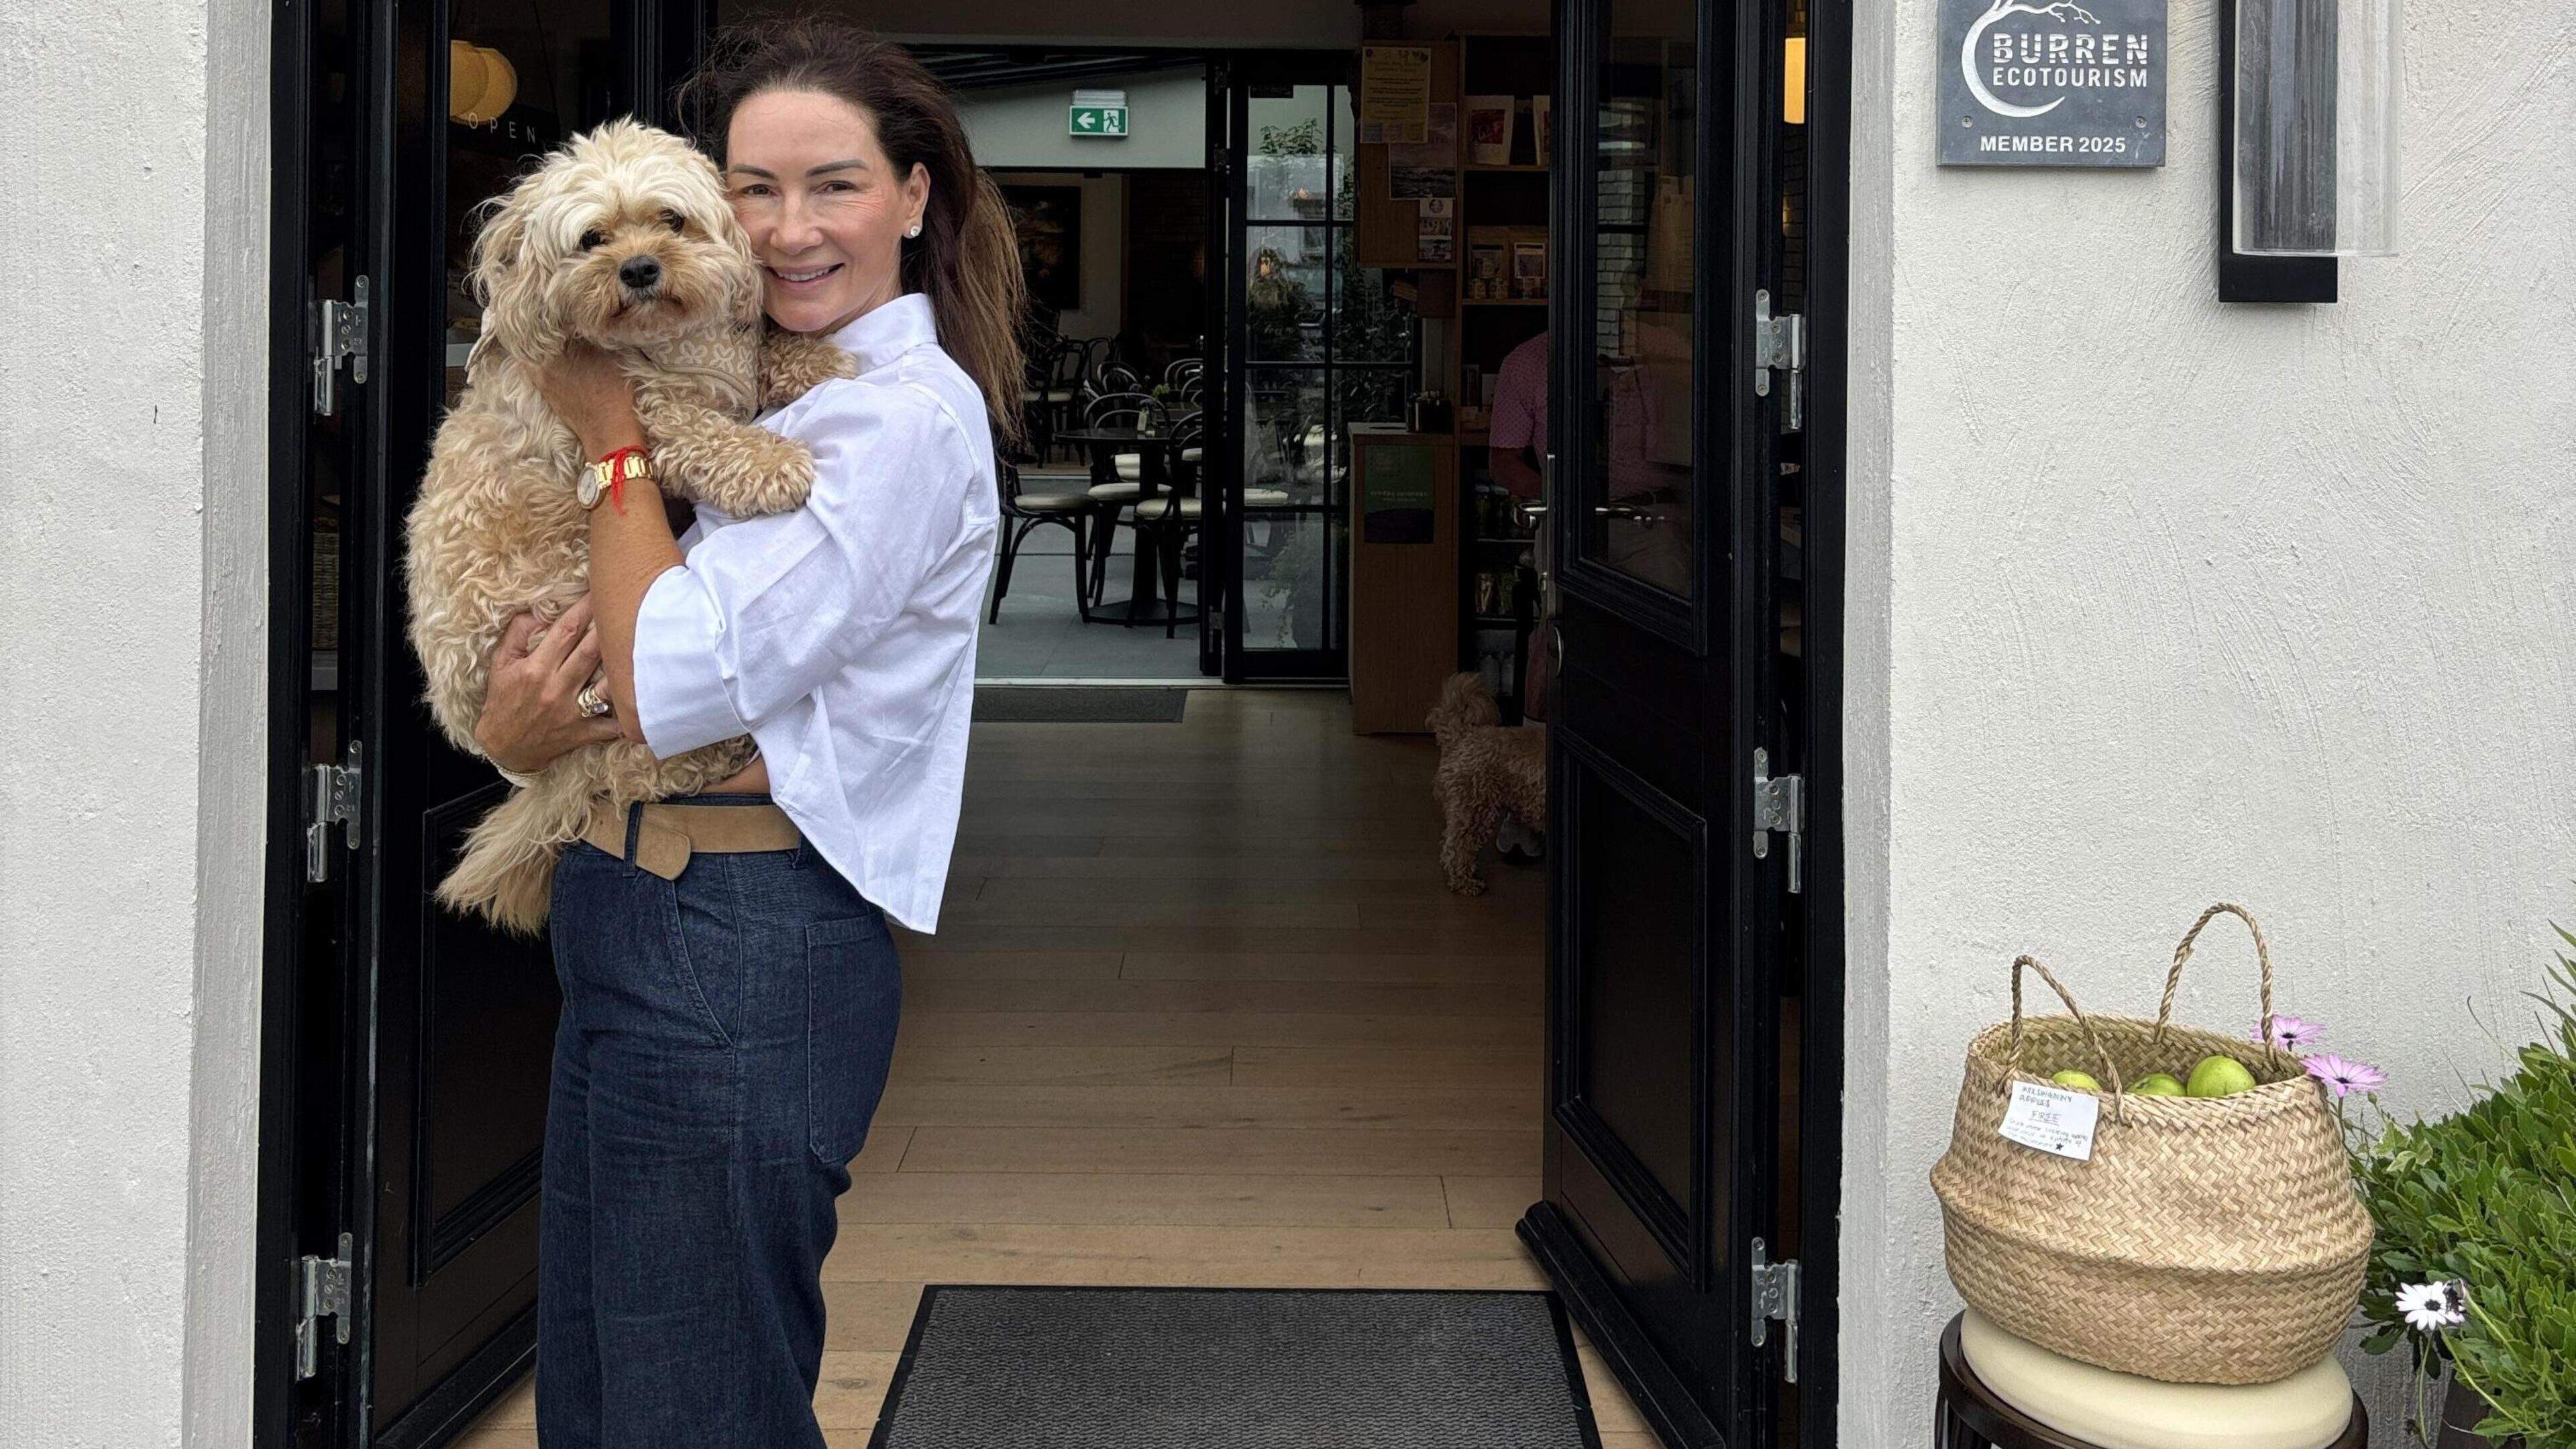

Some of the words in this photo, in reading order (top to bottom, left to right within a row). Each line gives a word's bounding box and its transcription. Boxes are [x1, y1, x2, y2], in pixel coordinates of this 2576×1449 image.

[1993, 33, 2147, 64] BURREN
[1992, 67, 2147, 88] ECOTOURISM
[469, 112, 536, 144] OPEN
[1980, 136, 2074, 153] MEMBER
[2079, 136, 2126, 154] 2025
[2031, 1110, 2062, 1123] FREE
